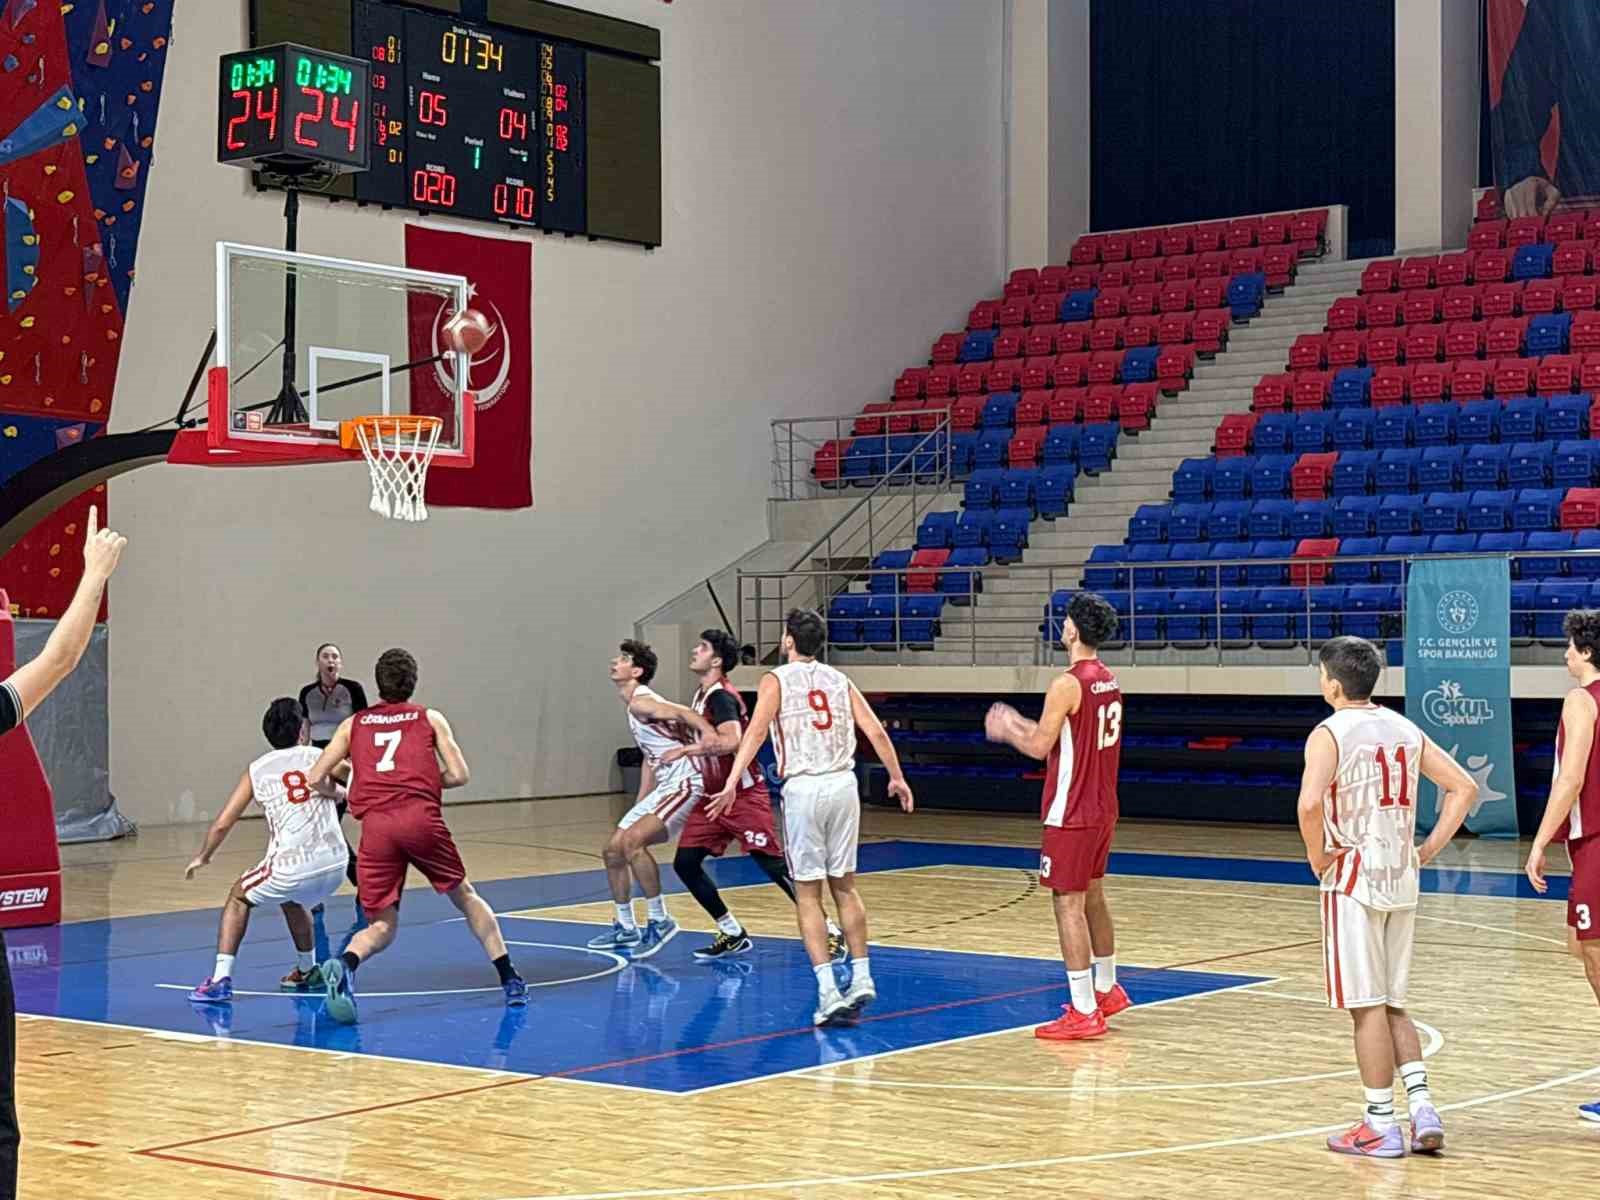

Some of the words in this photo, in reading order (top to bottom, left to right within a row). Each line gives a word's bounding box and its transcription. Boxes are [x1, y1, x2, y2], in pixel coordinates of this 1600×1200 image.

[231, 59, 275, 91] 01:34
[296, 58, 352, 95] 01:34
[227, 87, 278, 150] 24
[294, 87, 359, 152] 24
[419, 91, 447, 127] 05
[500, 108, 527, 140] 04
[474, 147, 480, 170] 1
[414, 170, 456, 207] 020
[494, 183, 534, 218] 010
[1417, 648, 1441, 659] SPOR
[1444, 647, 1498, 659] BAKANLIĞI
[1418, 637, 1436, 647] T.C.
[1438, 635, 1481, 649] GENÇLİK
[1483, 637, 1497, 647] VE
[807, 689, 833, 731] 9
[1097, 700, 1123, 751] 13
[374, 730, 402, 773] 7
[282, 770, 311, 805] 8
[1375, 745, 1411, 808] 11
[1575, 903, 1591, 931] 3
